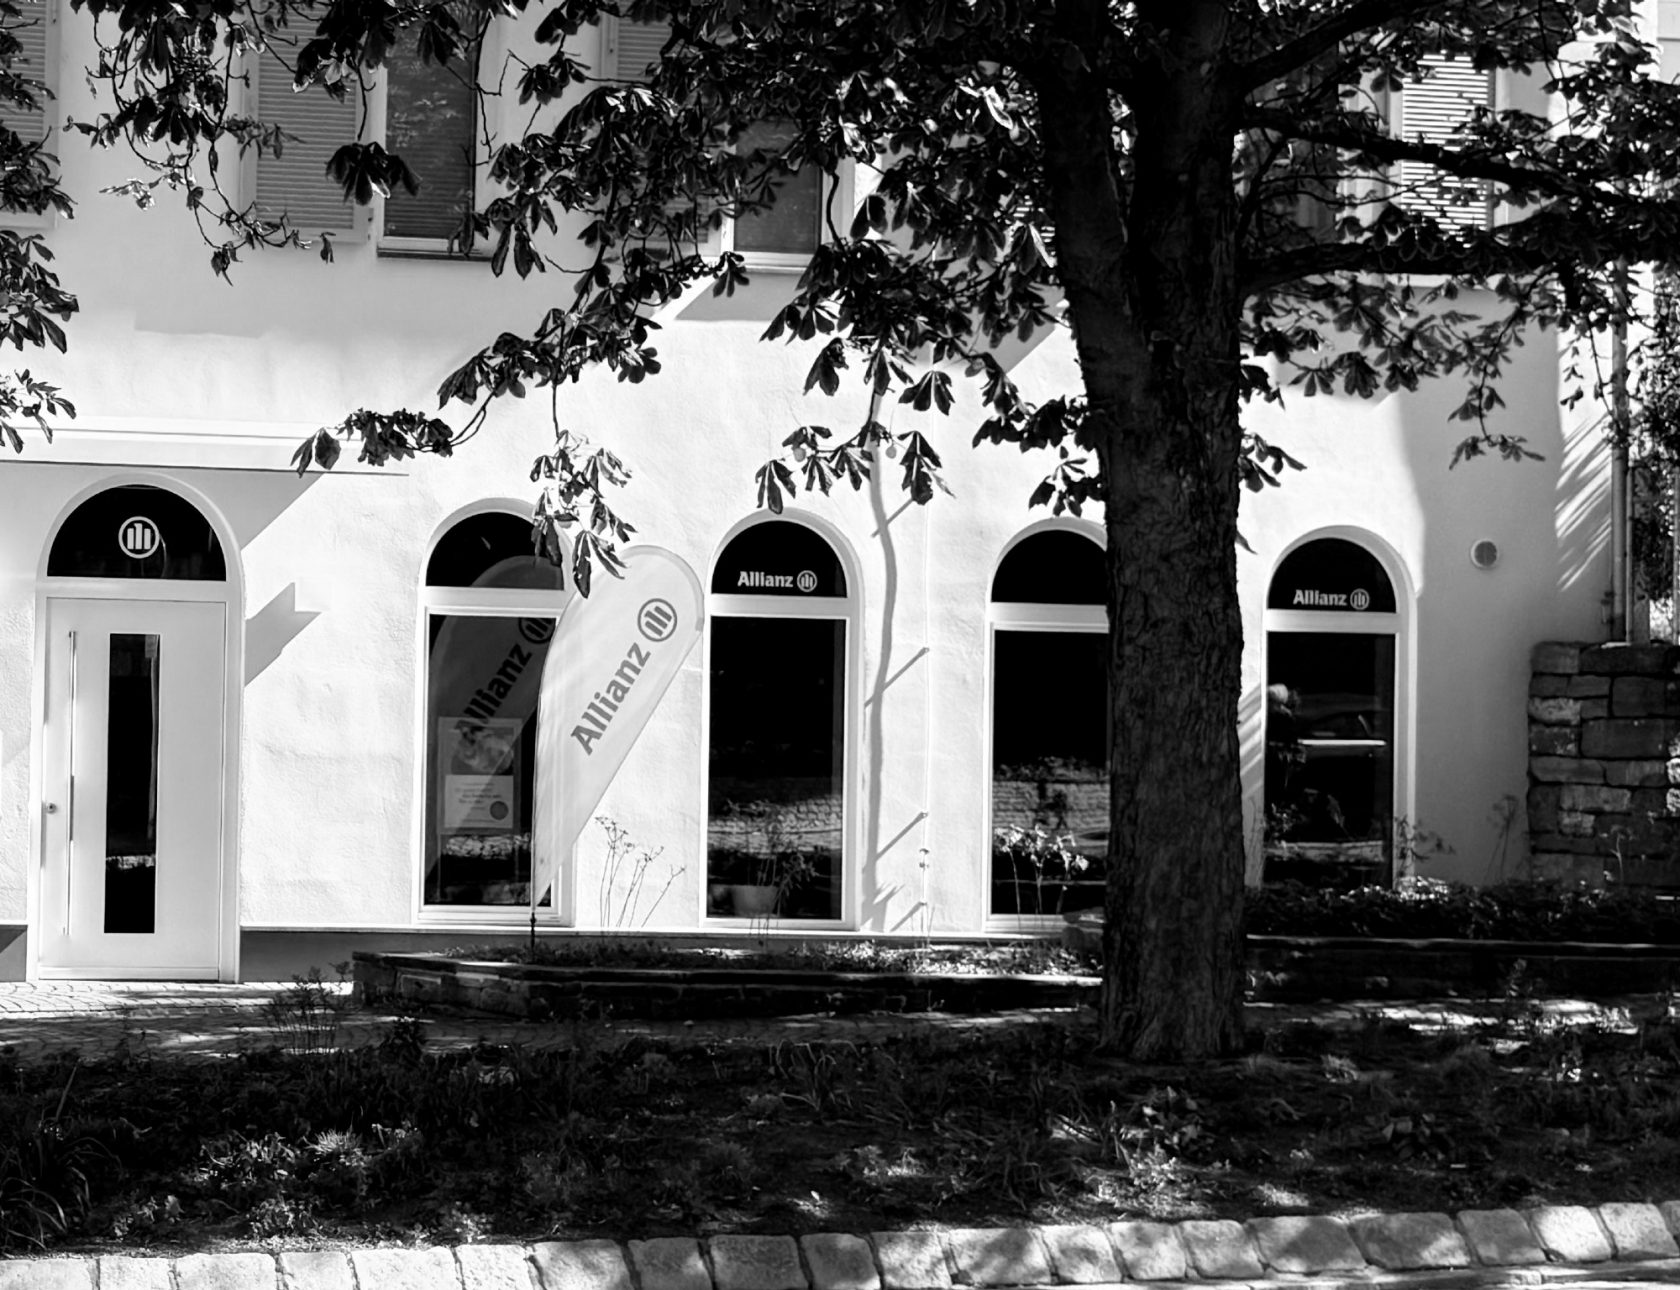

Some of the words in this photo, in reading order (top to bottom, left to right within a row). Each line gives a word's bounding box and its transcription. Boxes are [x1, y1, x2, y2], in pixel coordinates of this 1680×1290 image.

[737, 571, 794, 588] Allianz
[1293, 589, 1348, 606] Allianz
[570, 642, 651, 756] Allianz
